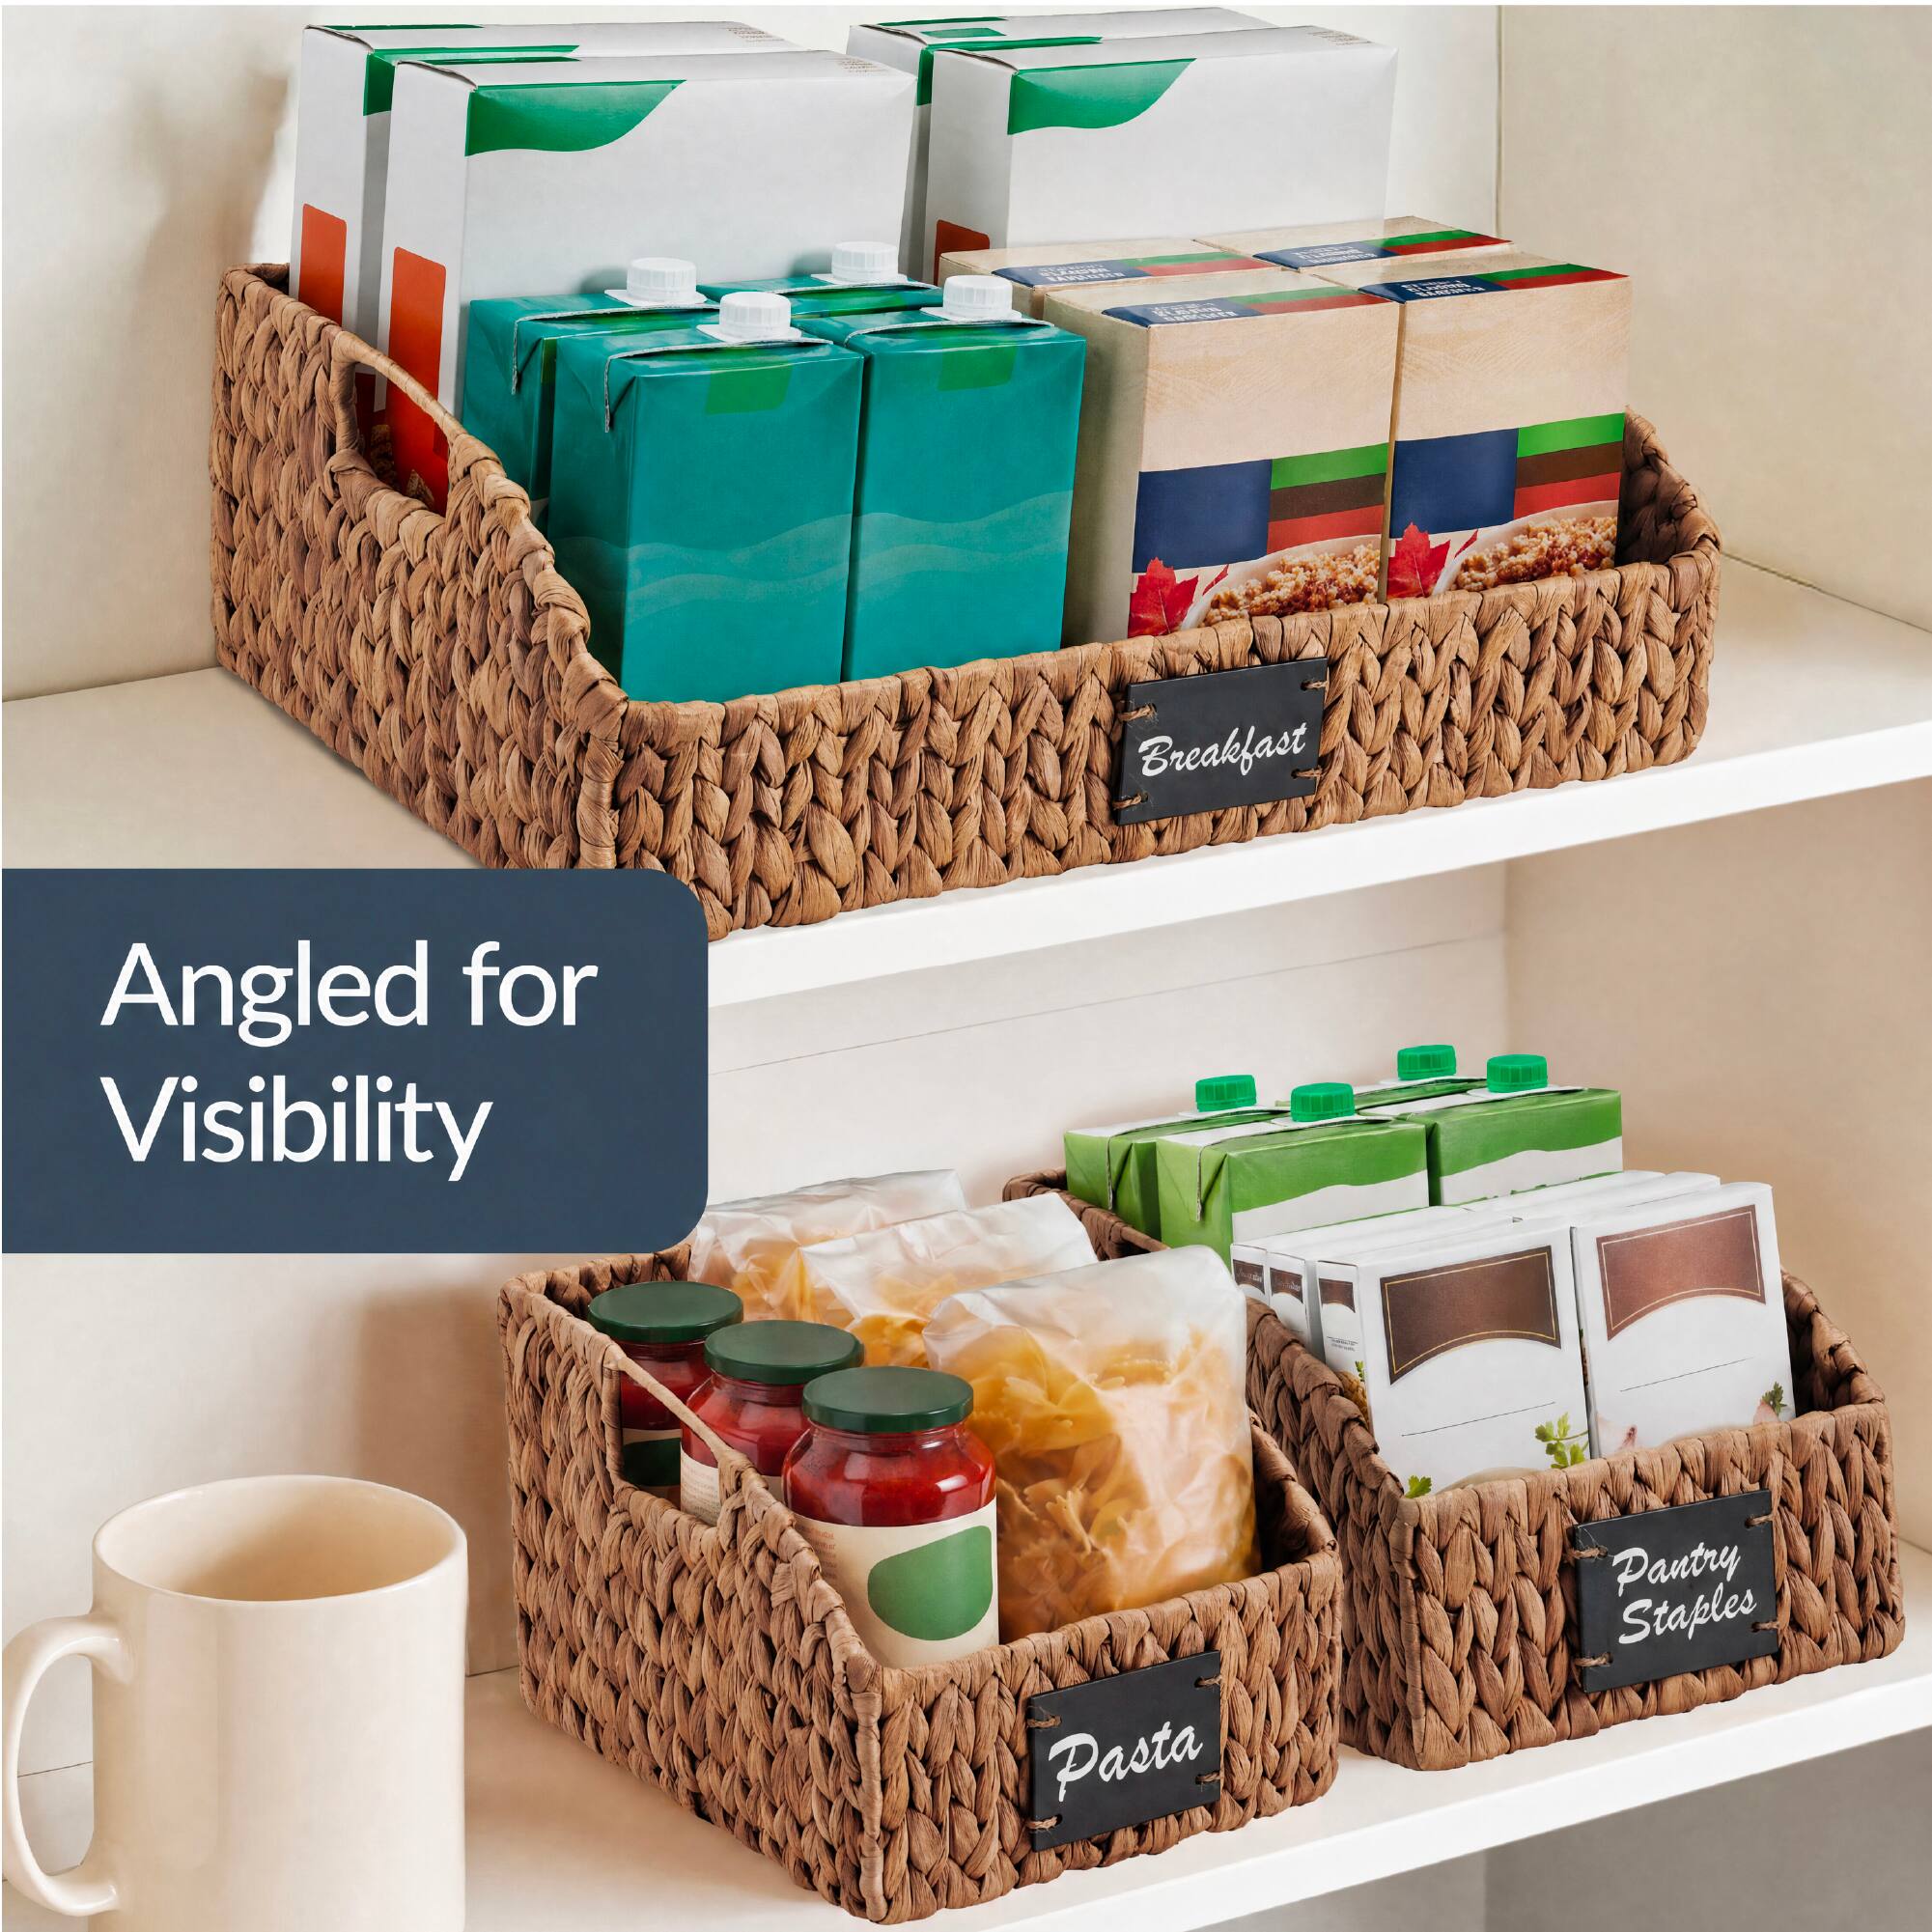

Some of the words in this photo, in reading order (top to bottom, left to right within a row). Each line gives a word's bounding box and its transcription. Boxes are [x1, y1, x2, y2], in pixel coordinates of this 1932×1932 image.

[1138, 722, 1307, 776] Breakfast
[1612, 1542, 1741, 1597] Pantry
[1618, 1582, 1757, 1644] Staples
[1049, 1721, 1204, 1803] Pasta
